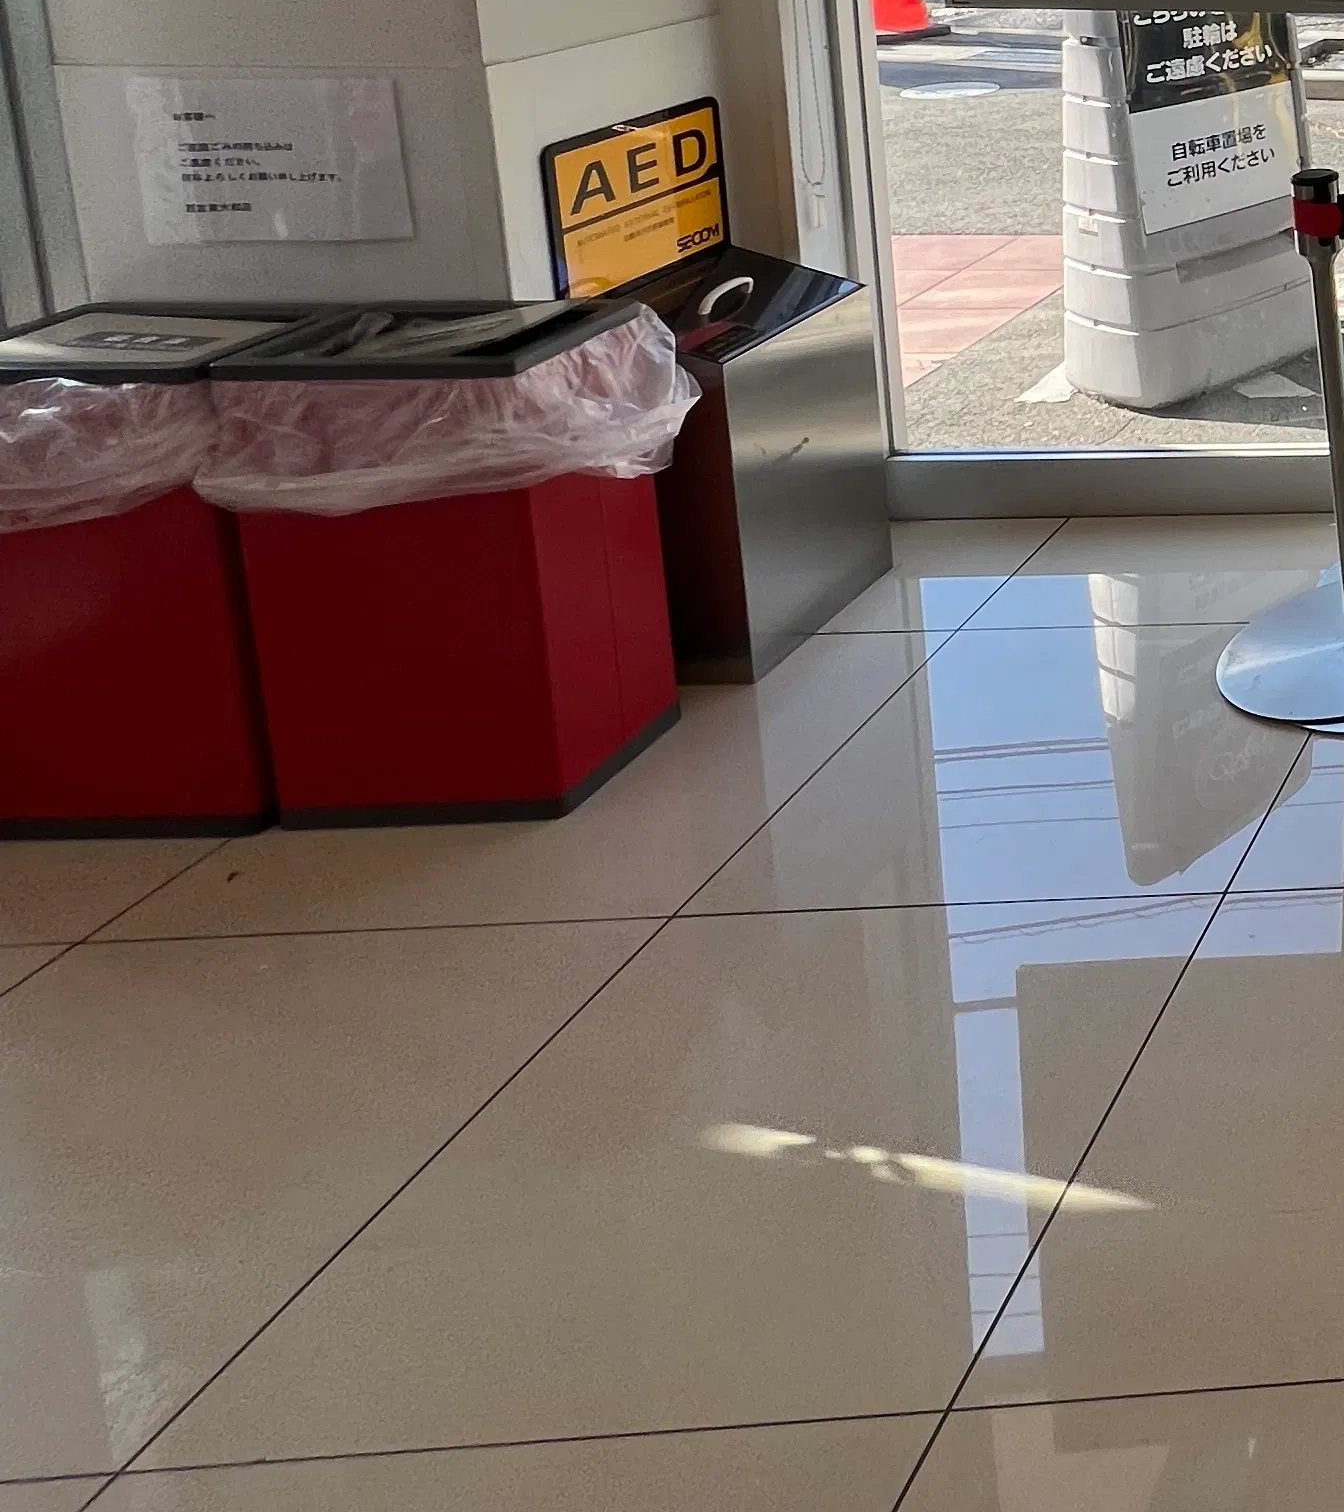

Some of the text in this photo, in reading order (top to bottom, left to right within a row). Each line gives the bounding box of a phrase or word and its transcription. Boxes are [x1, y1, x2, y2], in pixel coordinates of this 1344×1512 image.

[1182, 21, 1238, 49] 駐輪は
[1146, 45, 1273, 84] ご遠慮ください
[1171, 123, 1267, 162] 自転車置場を
[570, 128, 707, 217] AED
[1166, 148, 1275, 188] ご利用ください
[676, 223, 720, 253] SECOM
